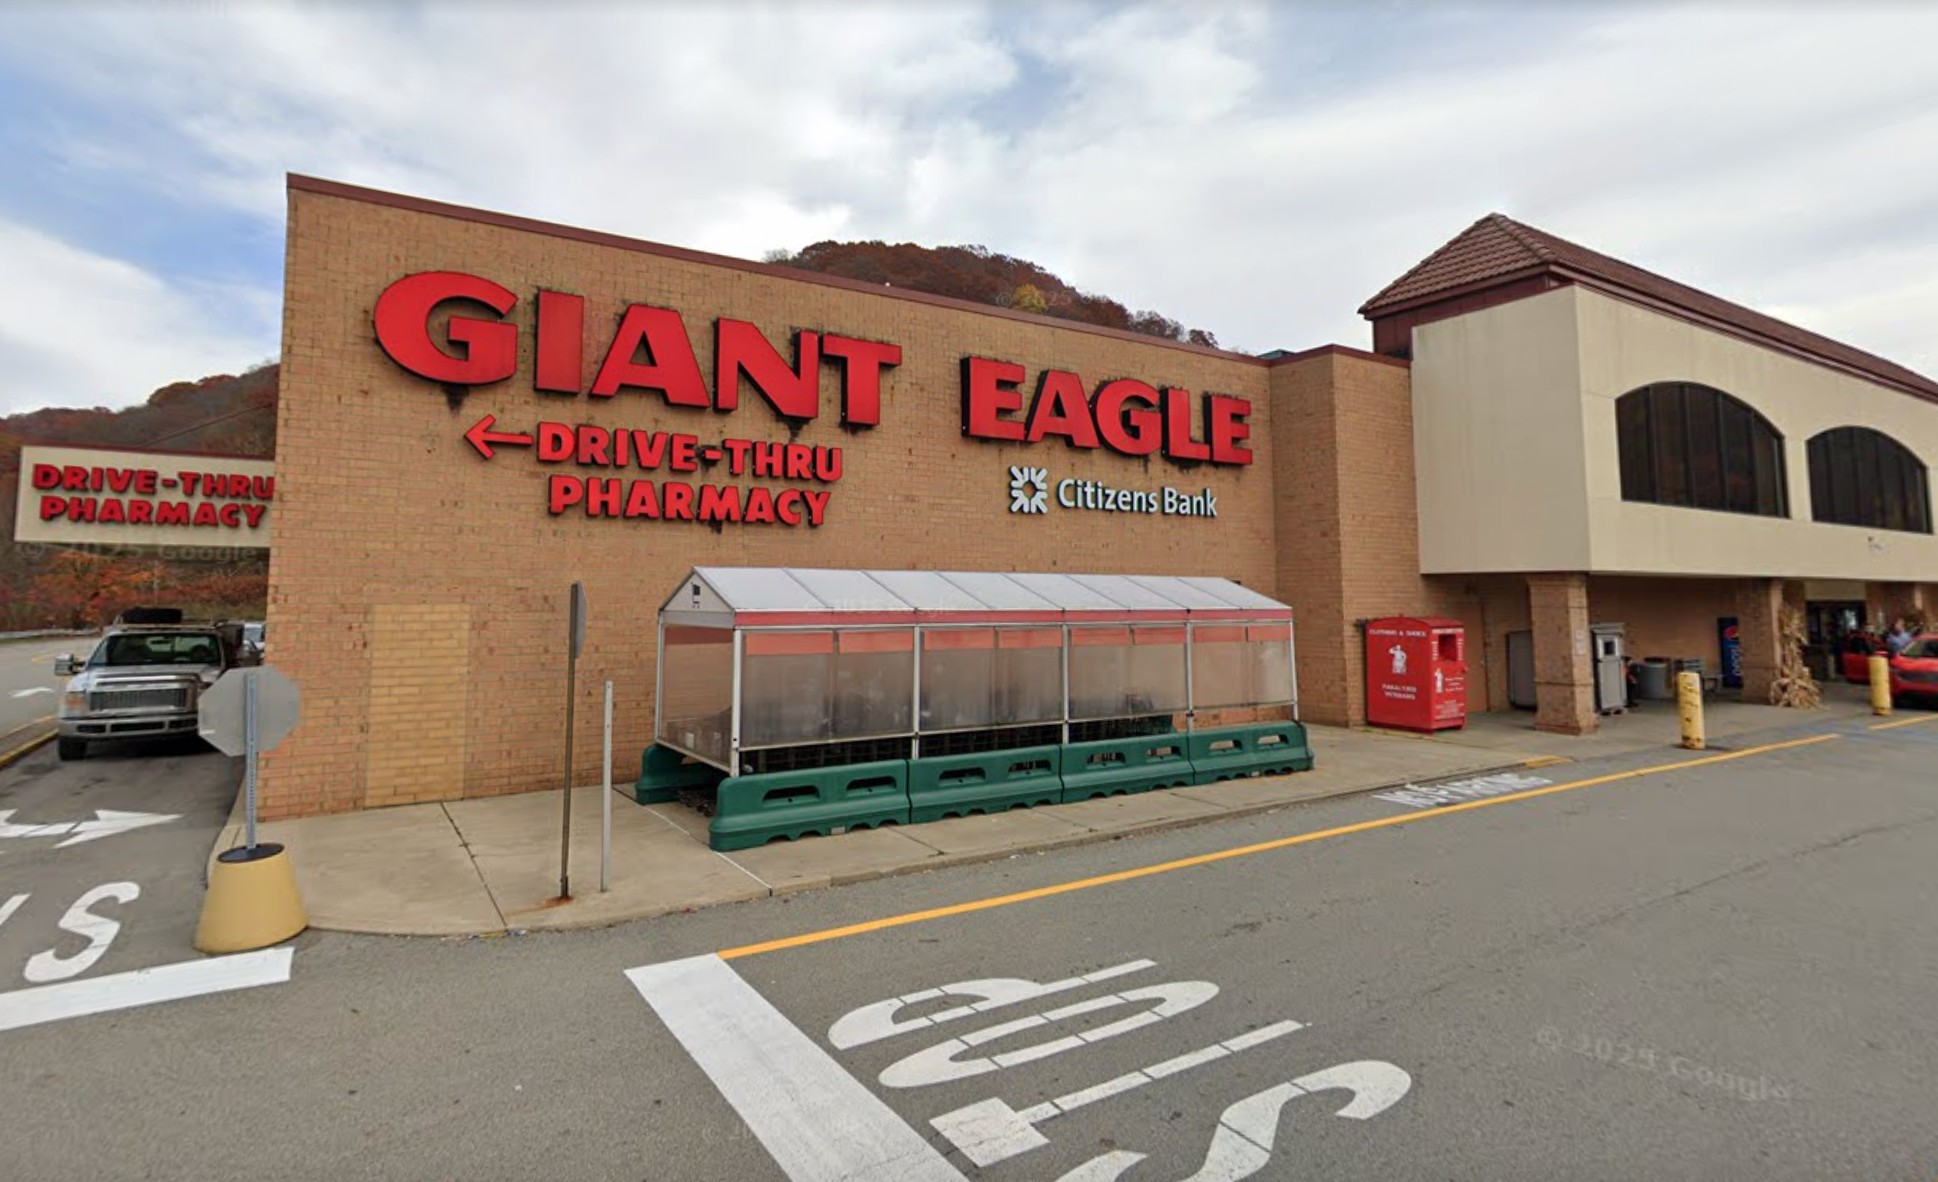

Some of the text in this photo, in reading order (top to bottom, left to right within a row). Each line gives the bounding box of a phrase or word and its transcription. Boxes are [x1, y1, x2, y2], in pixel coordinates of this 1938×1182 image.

[373, 270, 1253, 466] GIANT EAGLE
[537, 421, 843, 483] DRIVE-THRU
[32, 463, 275, 500] DRIVE-THRU
[548, 474, 831, 526] PHARMACY
[1057, 478, 1217, 517] Citizens Bank
[39, 494, 267, 529] PHARMACY
[828, 958, 1412, 1182] STOP
